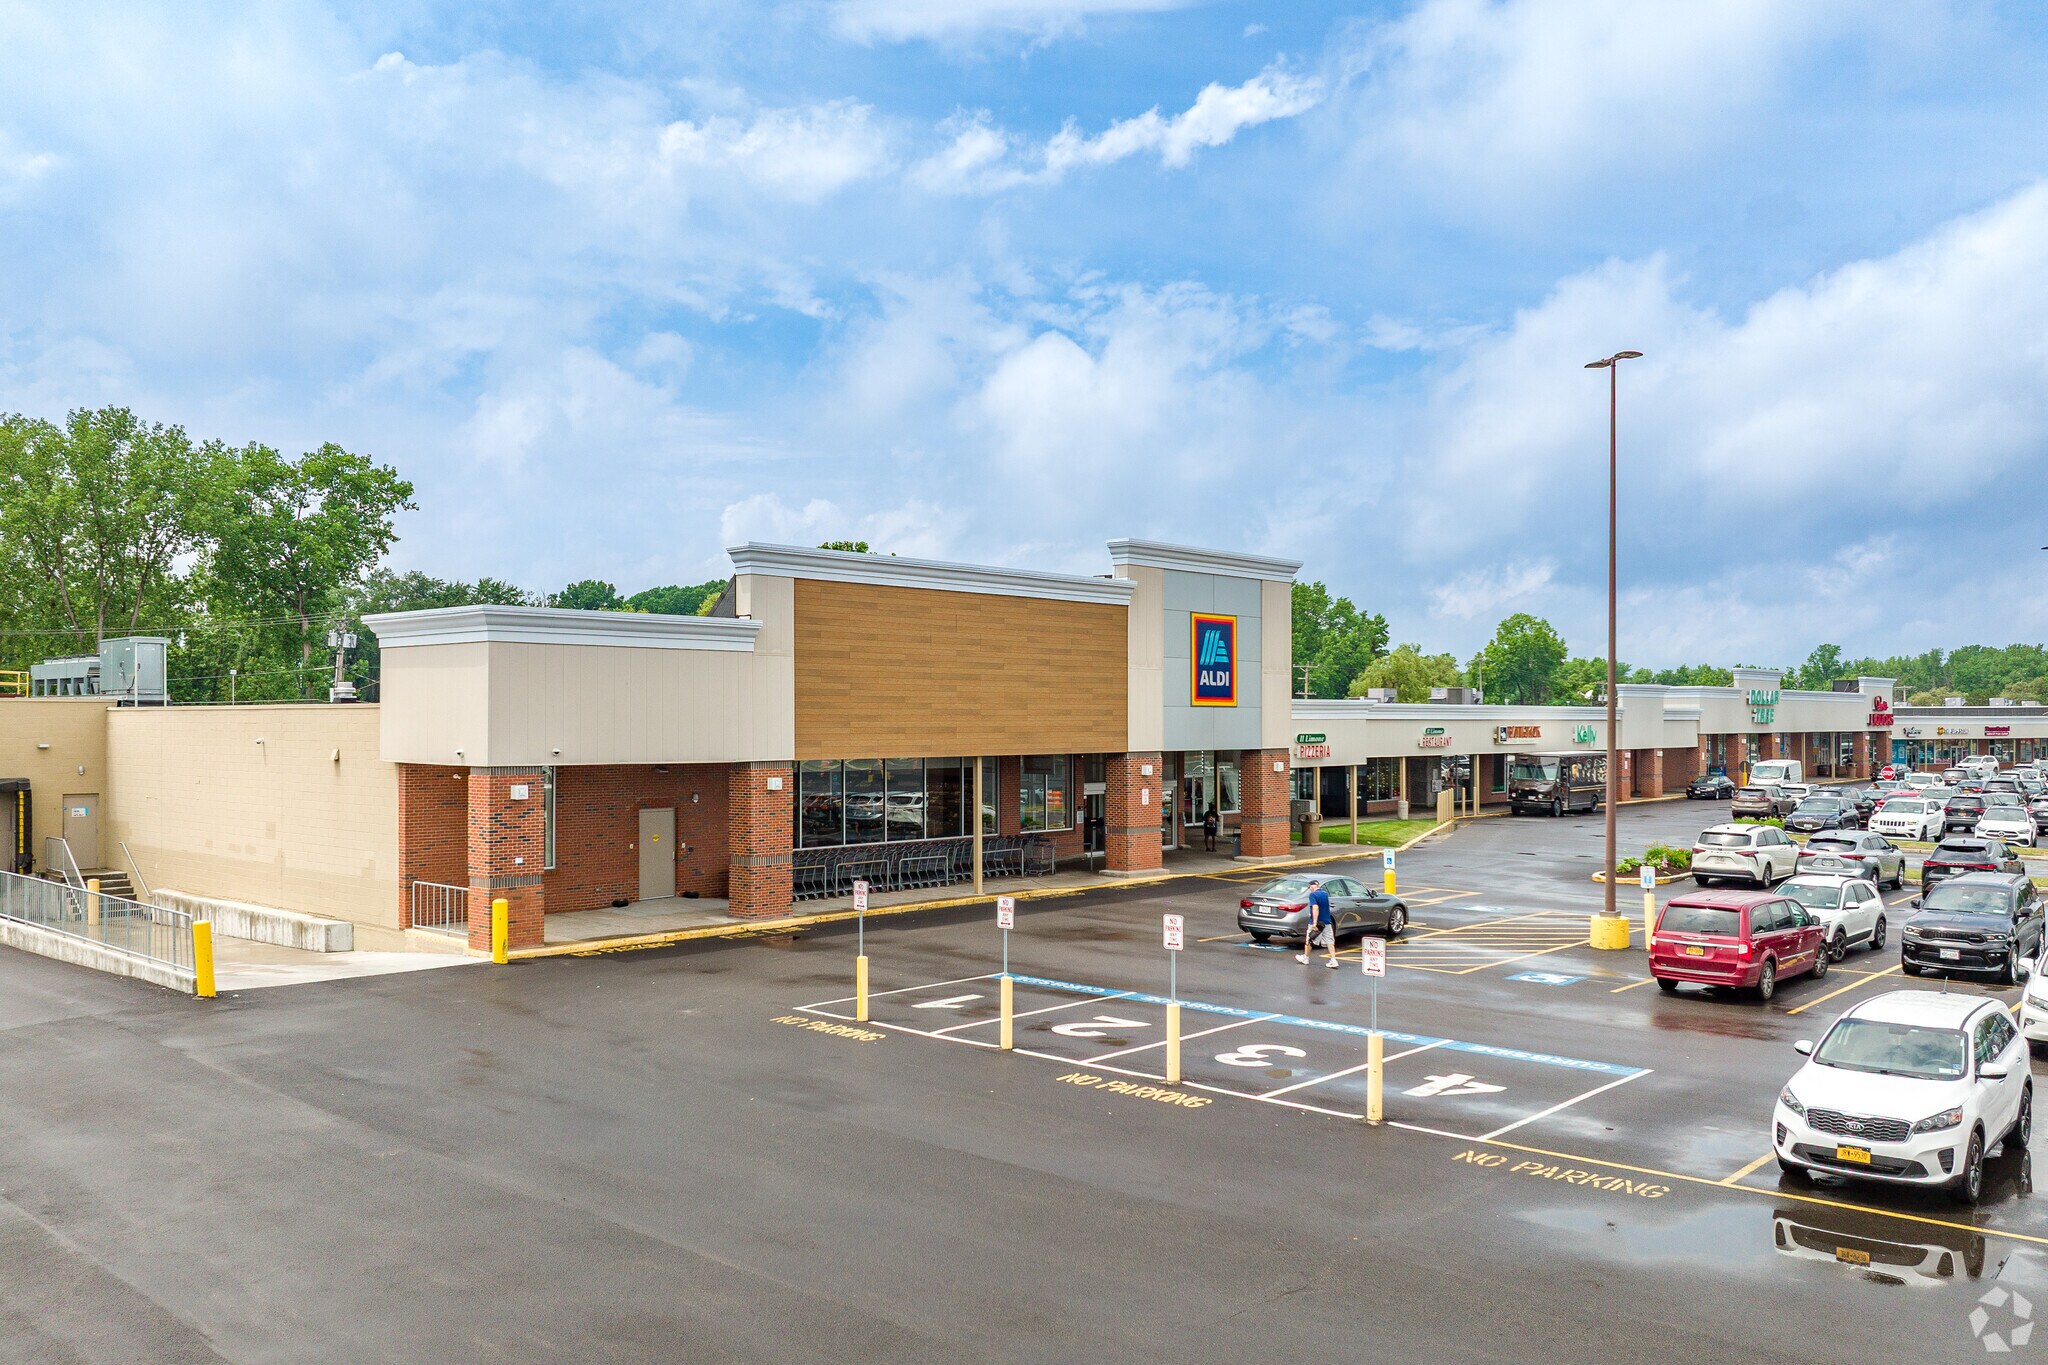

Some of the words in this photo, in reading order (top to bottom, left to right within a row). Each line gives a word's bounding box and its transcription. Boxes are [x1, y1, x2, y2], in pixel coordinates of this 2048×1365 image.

[1200, 670, 1230, 686] ALDI
[1749, 690, 1779, 704] DOLLAR
[1755, 708, 1775, 723] TREE
[1422, 736, 1452, 746] RESTAURANT
[1575, 725, 1597, 748] Kelly
[1300, 745, 1330, 758] PIZZERIA
[1364, 949, 1384, 957] PARKING
[911, 994, 984, 1009] 1
[769, 1015, 809, 1025] NO
[797, 1020, 887, 1042] PARKING
[1050, 1015, 1152, 1038] 2
[1213, 1043, 1307, 1069] 3
[1467, 1046, 1612, 1071] CURBSIDE
[1054, 1071, 1103, 1088] NO
[1095, 1080, 1213, 1109] PARKING
[1400, 1072, 1508, 1098] 4
[1450, 1149, 1509, 1167] NO
[1509, 1159, 1673, 1199] PARKING
